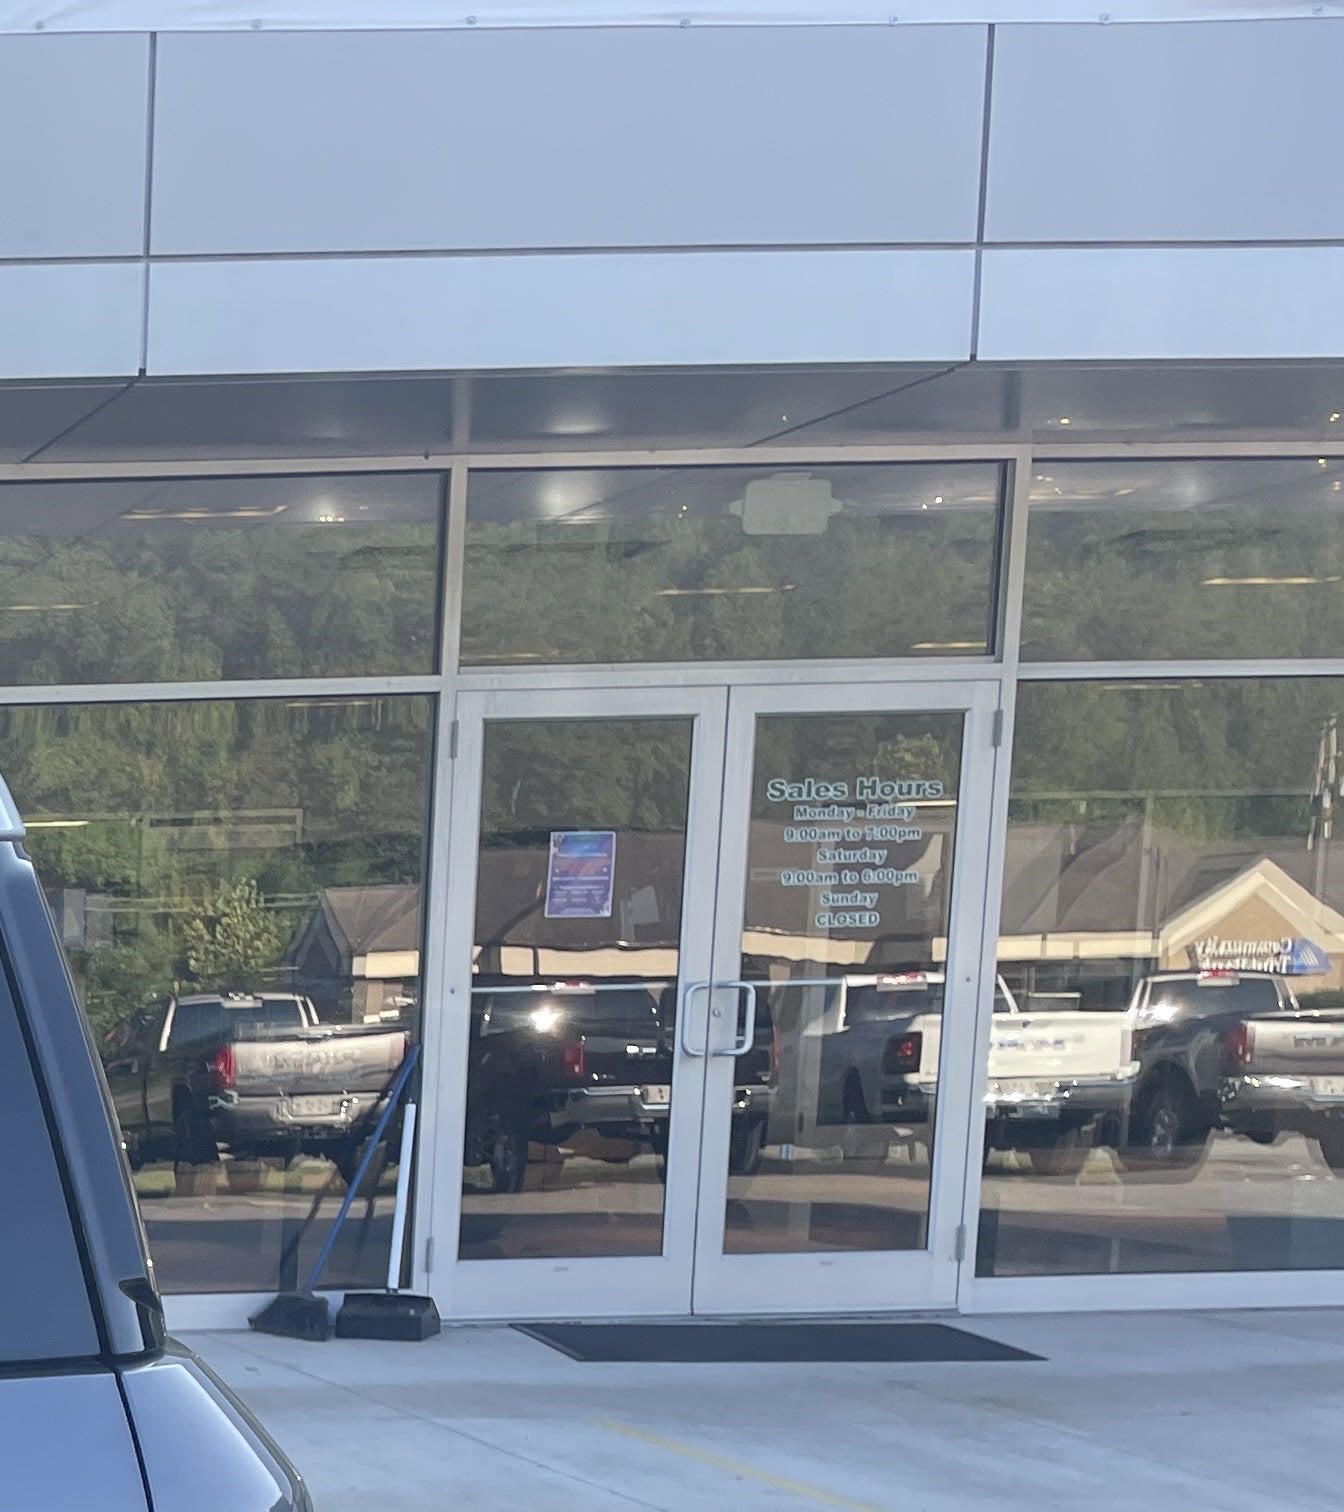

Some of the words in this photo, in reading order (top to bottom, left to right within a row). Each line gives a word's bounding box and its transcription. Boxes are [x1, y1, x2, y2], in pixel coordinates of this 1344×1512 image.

[767, 778, 848, 801] Sales
[856, 777, 944, 799] Hours
[794, 805, 855, 822] Monday
[866, 805, 914, 820] Friday
[784, 828, 841, 842] 9:00am
[845, 827, 861, 841] to
[864, 826, 921, 843] 7:00pm
[817, 849, 887, 865] Saturday
[781, 871, 838, 885] 9:00am
[841, 870, 858, 884] to
[820, 892, 879, 908] Sunday
[815, 912, 880, 928] CLOSED
